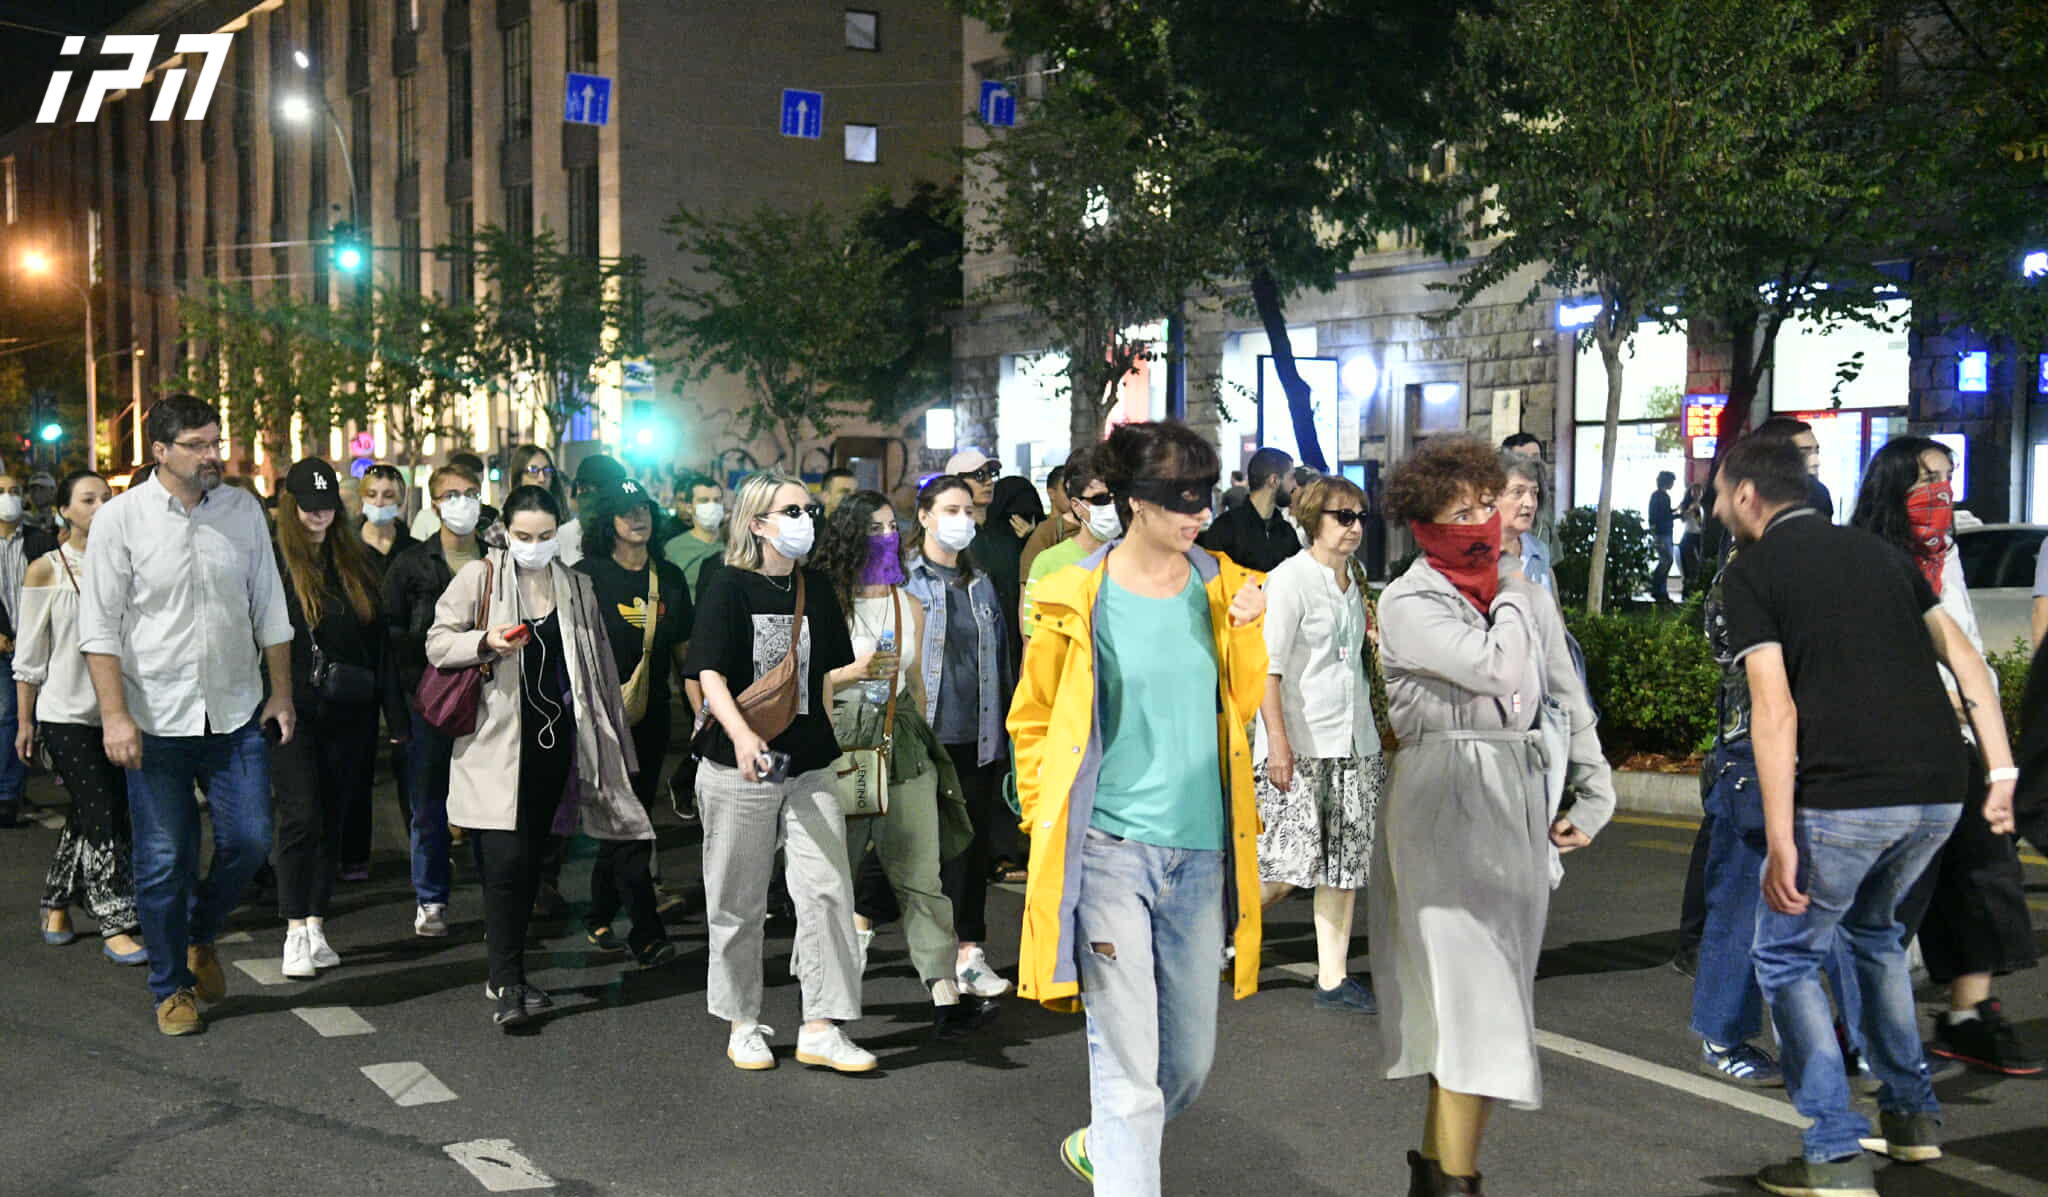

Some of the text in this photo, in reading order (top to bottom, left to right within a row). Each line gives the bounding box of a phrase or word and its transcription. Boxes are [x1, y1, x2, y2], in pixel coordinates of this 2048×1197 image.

[313, 472, 328, 490] LA
[622, 481, 639, 494] NY
[855, 760, 866, 809] ENTINO
